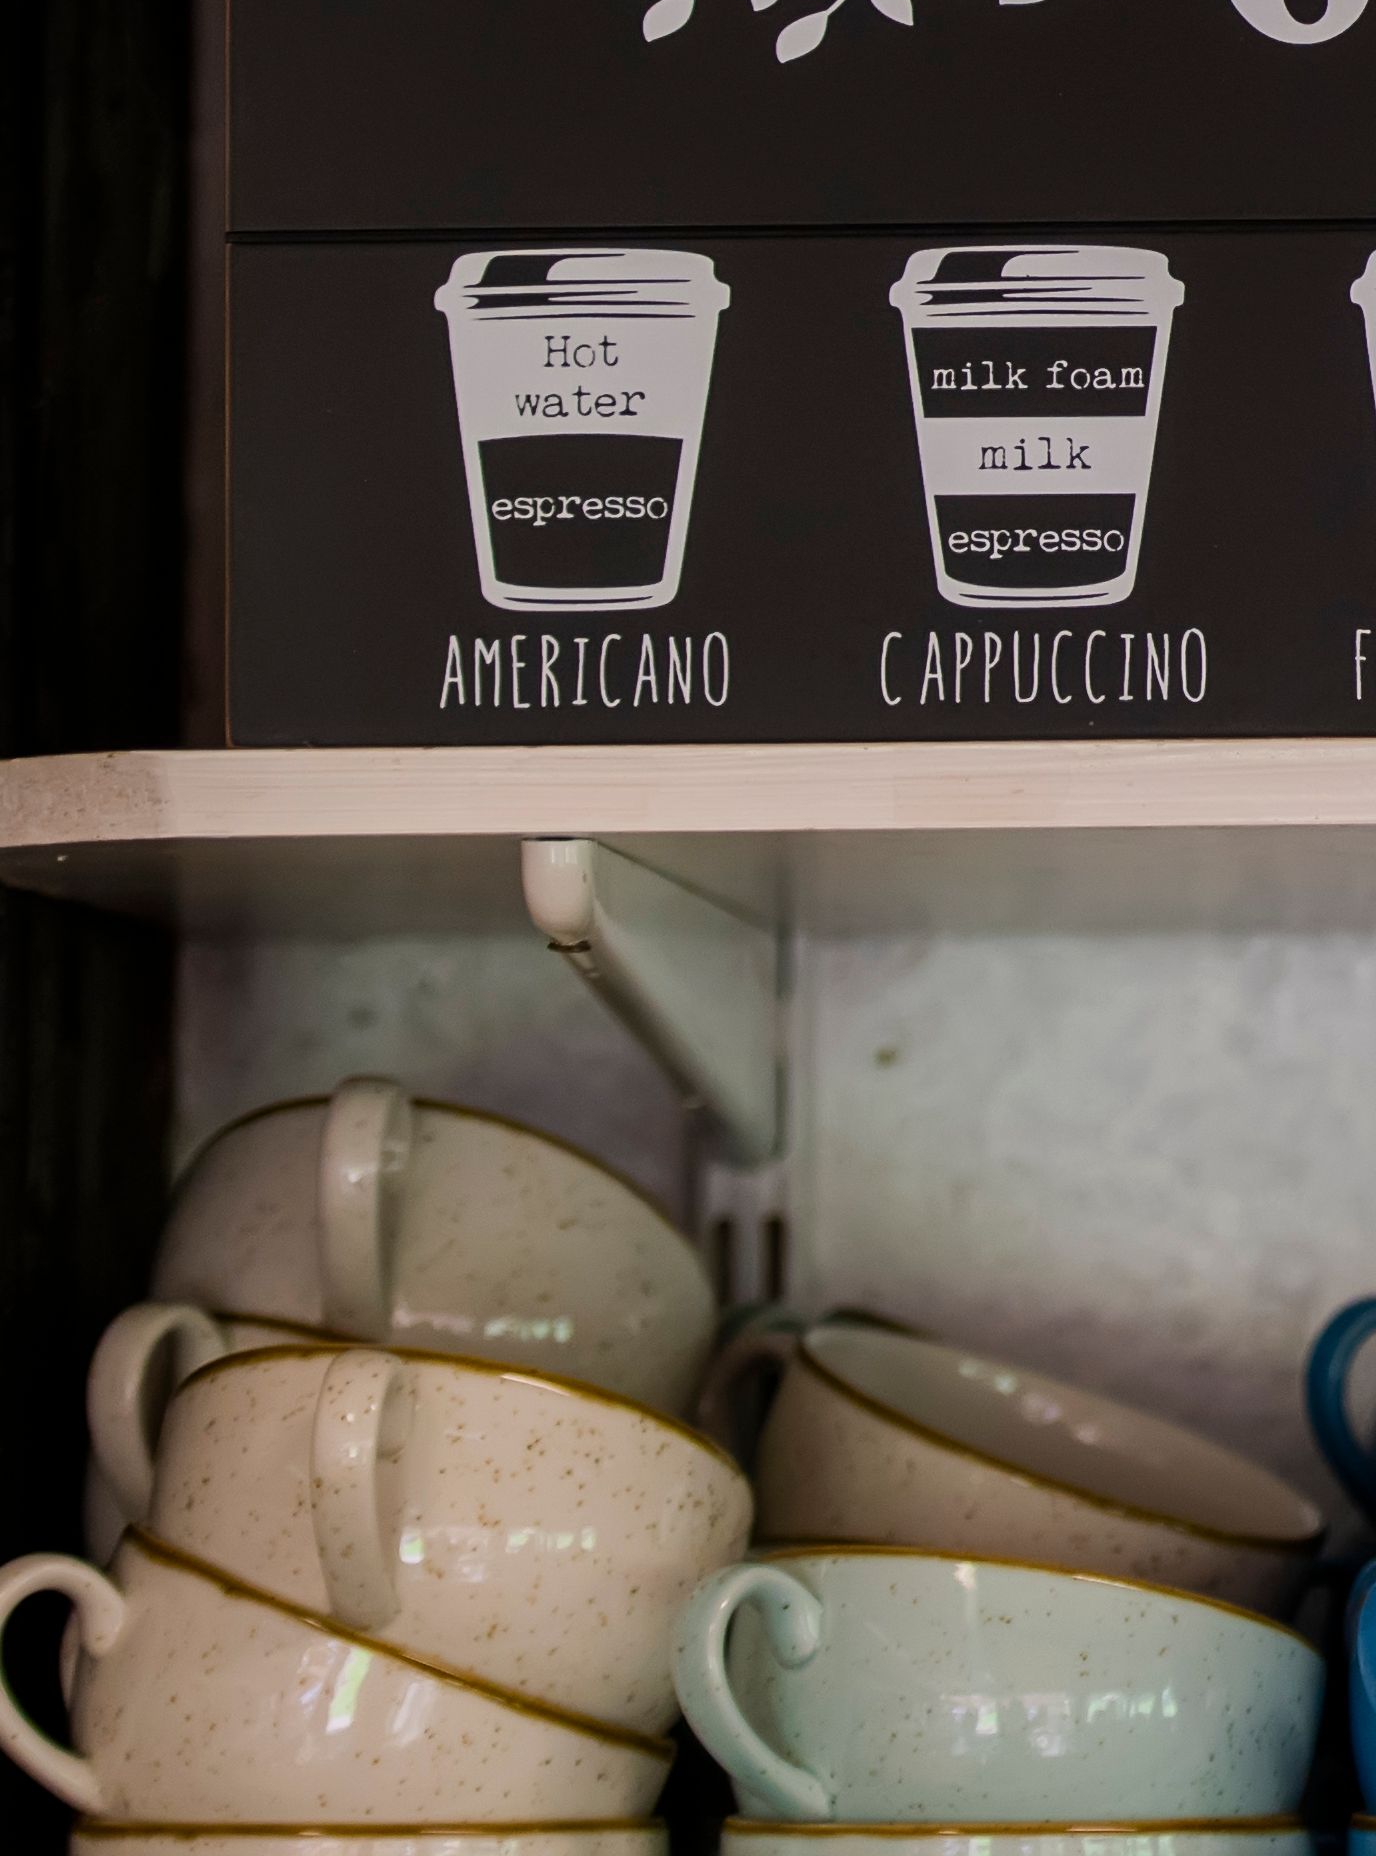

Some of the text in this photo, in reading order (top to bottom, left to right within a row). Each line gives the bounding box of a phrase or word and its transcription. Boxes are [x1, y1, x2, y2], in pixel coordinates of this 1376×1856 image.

[543, 334, 619, 370] Hot
[930, 360, 1146, 390] milk foam
[513, 386, 646, 418] water
[979, 437, 1092, 472] milk
[492, 493, 668, 526] espresso
[948, 526, 1125, 559] espresso
[439, 631, 730, 710] AMERICANO
[881, 627, 1207, 706] CAPPUCCINO
